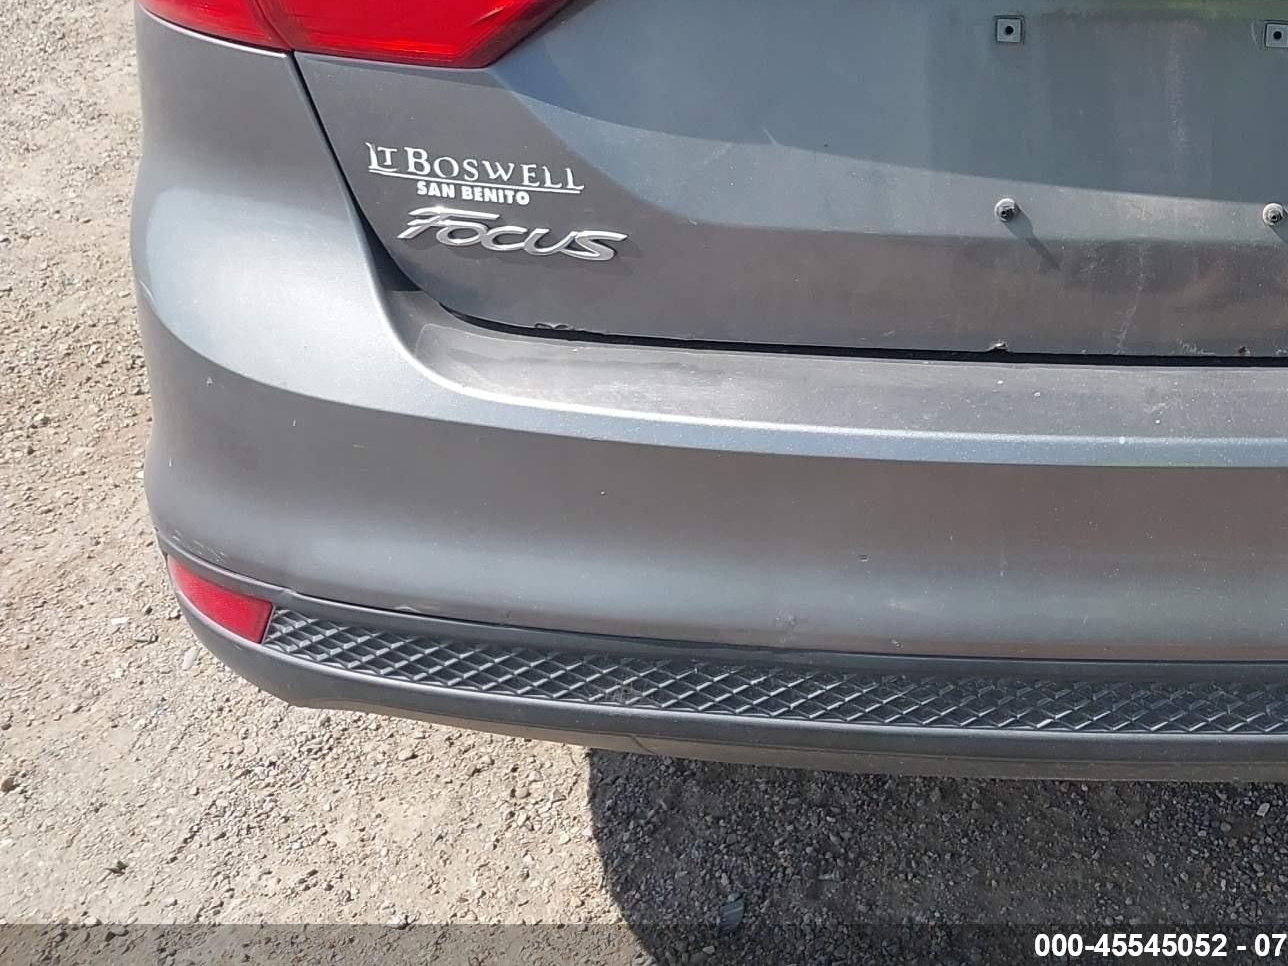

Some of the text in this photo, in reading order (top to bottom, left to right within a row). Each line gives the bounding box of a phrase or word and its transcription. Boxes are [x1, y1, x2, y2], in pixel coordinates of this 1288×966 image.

[404, 146, 584, 190] BOSWELL
[417, 181, 530, 205] SAN BENITO
